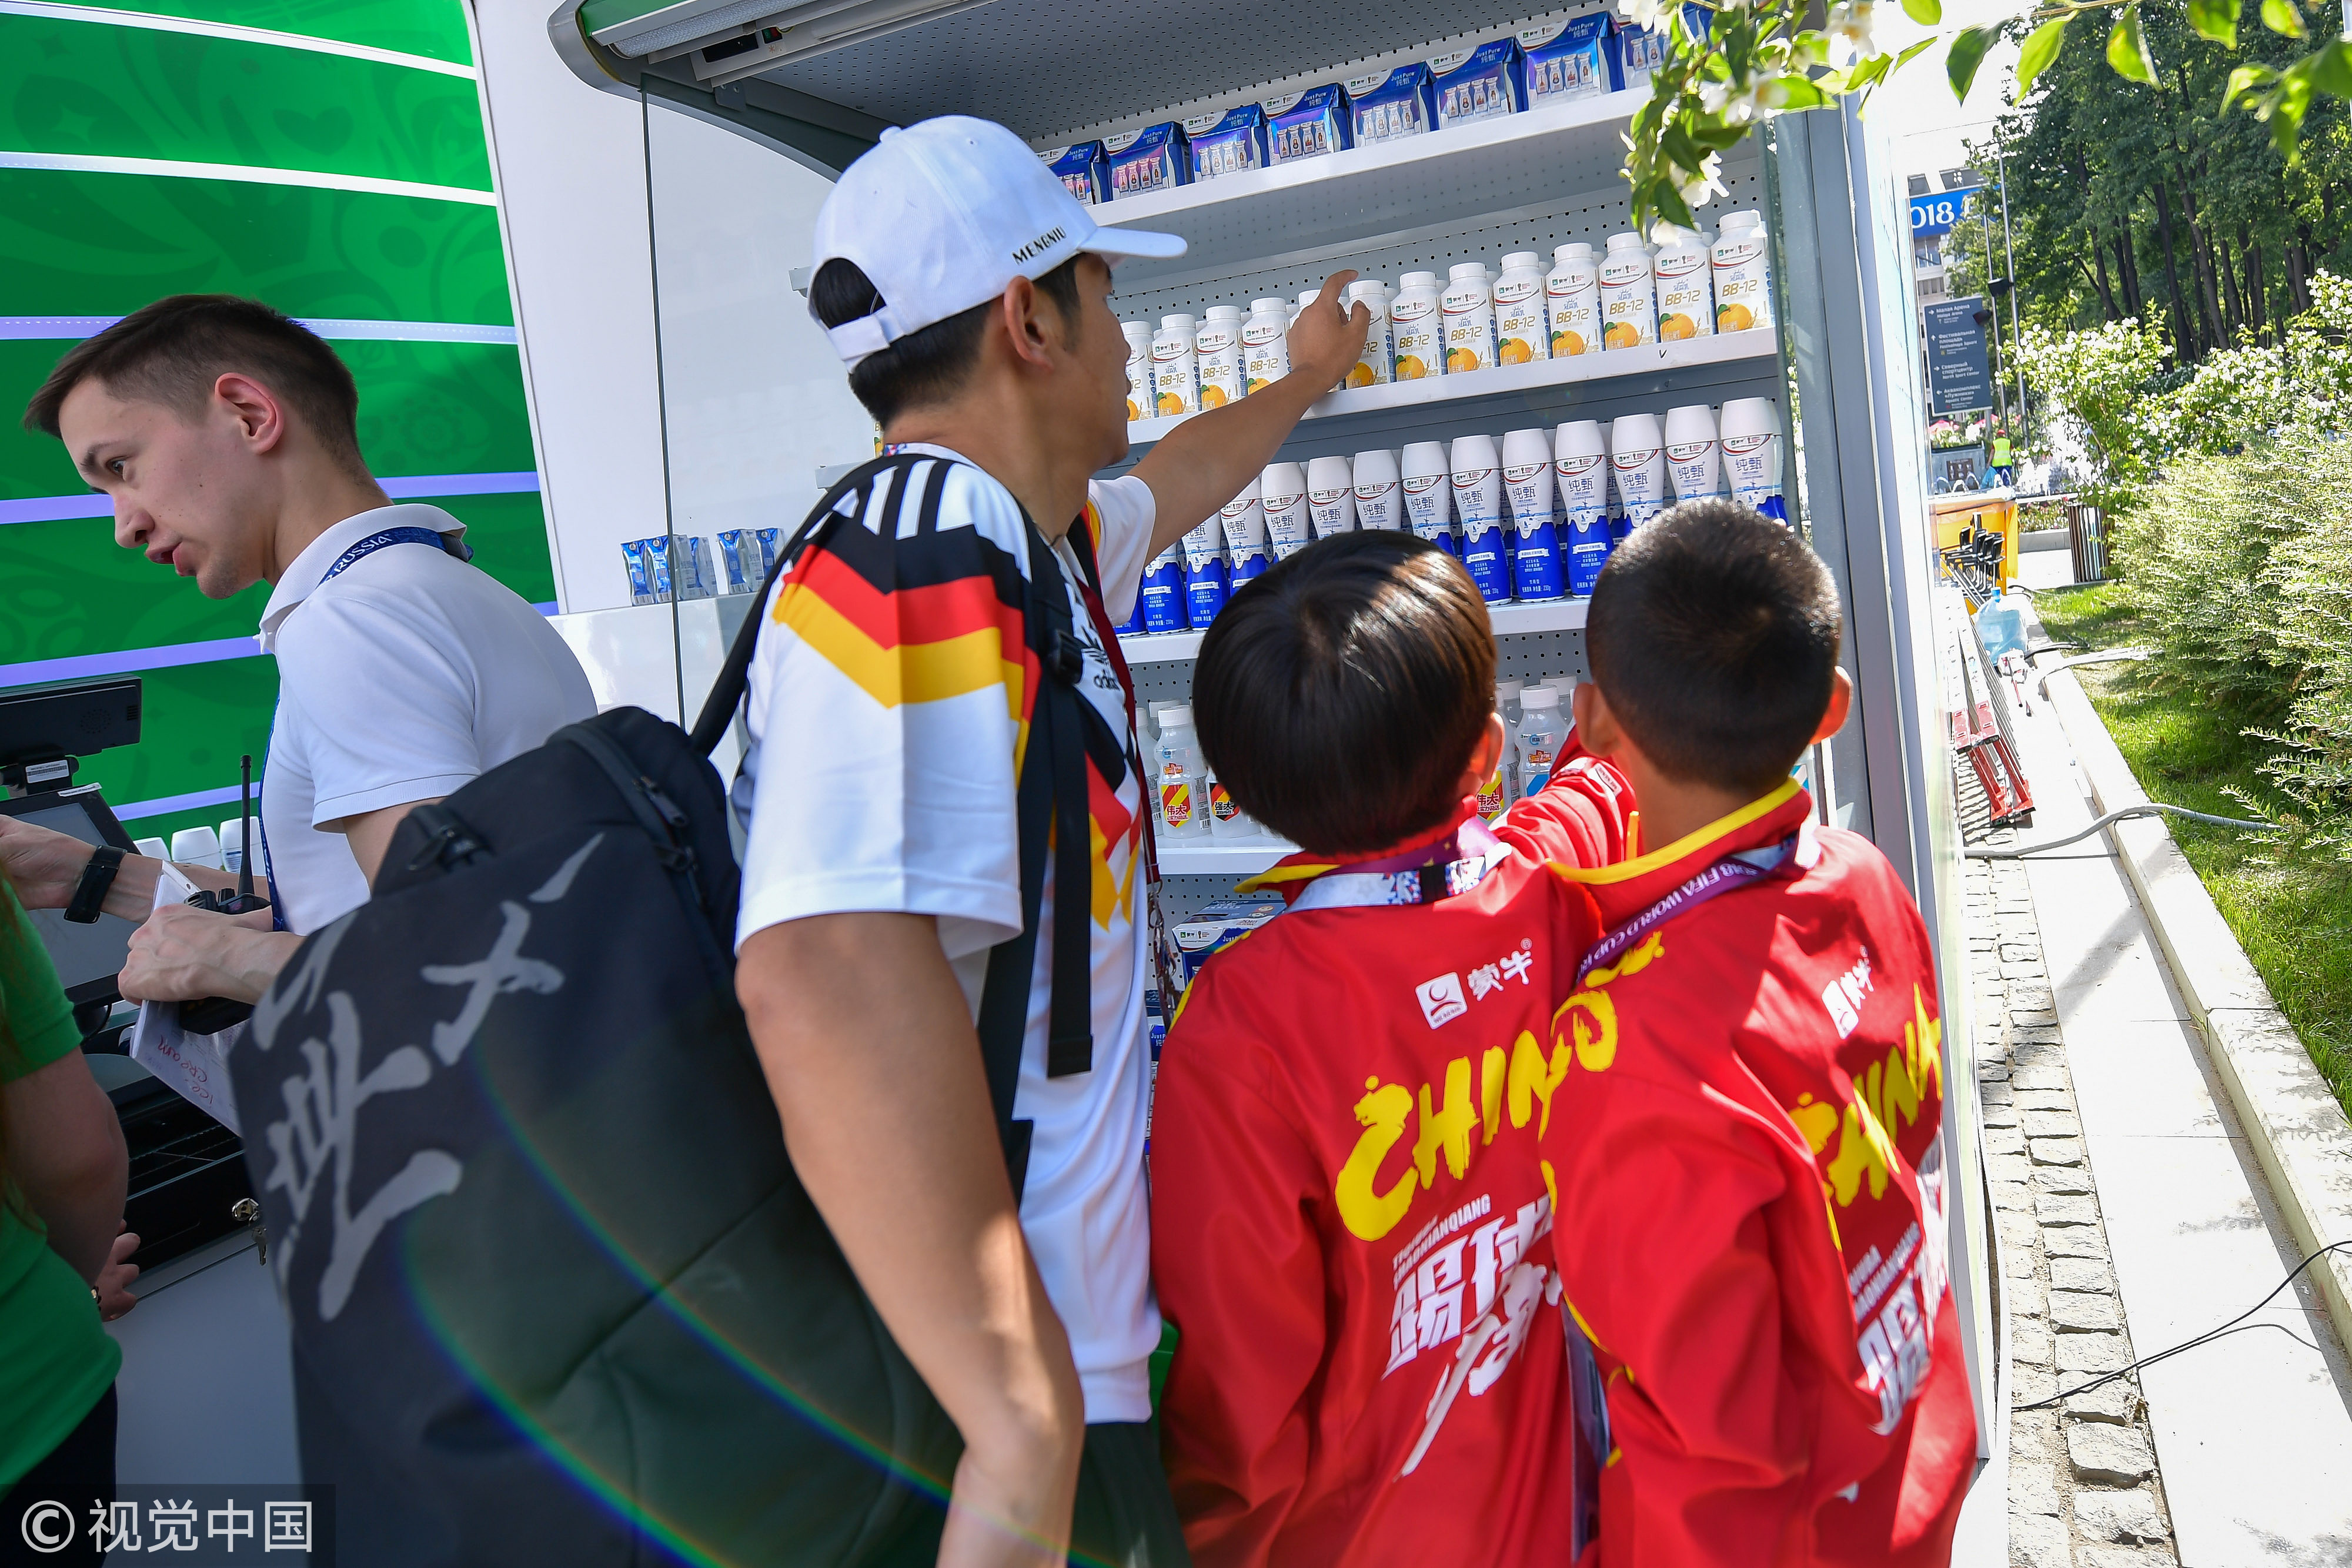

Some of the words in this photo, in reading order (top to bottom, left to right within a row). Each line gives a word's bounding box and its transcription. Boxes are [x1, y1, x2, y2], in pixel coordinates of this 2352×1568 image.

[1011, 225, 1067, 265] MENGNIU
[1722, 280, 1758, 297] BB-12
[1665, 290, 1700, 306] BB-12
[1609, 299, 1643, 315] BB-12
[1556, 308, 1589, 324] BB-12
[1503, 316, 1535, 332] BB-12
[1451, 326, 1482, 341] BB-12
[1399, 335, 1430, 349] BB-12
[1202, 366, 1230, 379] BB-12
[1250, 358, 1278, 372] BB-12
[1159, 373, 1186, 386] BB-12
[1678, 464, 1705, 479] 纯甄
[1735, 457, 1763, 472] 纯甄
[1568, 477, 1593, 492] 纯甄
[1623, 473, 1648, 487] 纯甄
[1461, 490, 1483, 504] 纯甄
[1512, 486, 1536, 499] 纯甄
[1363, 503, 1387, 516] 纯甄
[1411, 496, 1434, 509] 纯甄
[1271, 514, 1294, 528] 纯甄
[1317, 509, 1341, 521] 纯甄
[1227, 520, 1246, 532] 纯甄
[334, 534, 392, 573] RUSSIA
[1167, 804, 1187, 815] 伟大
[1215, 801, 1234, 811] 强大
[1680, 867, 1721, 897] FIFA
[1626, 890, 1683, 938] WORLD
[1594, 931, 1626, 960] CUP
[1467, 950, 1534, 1002] 蒙牛
